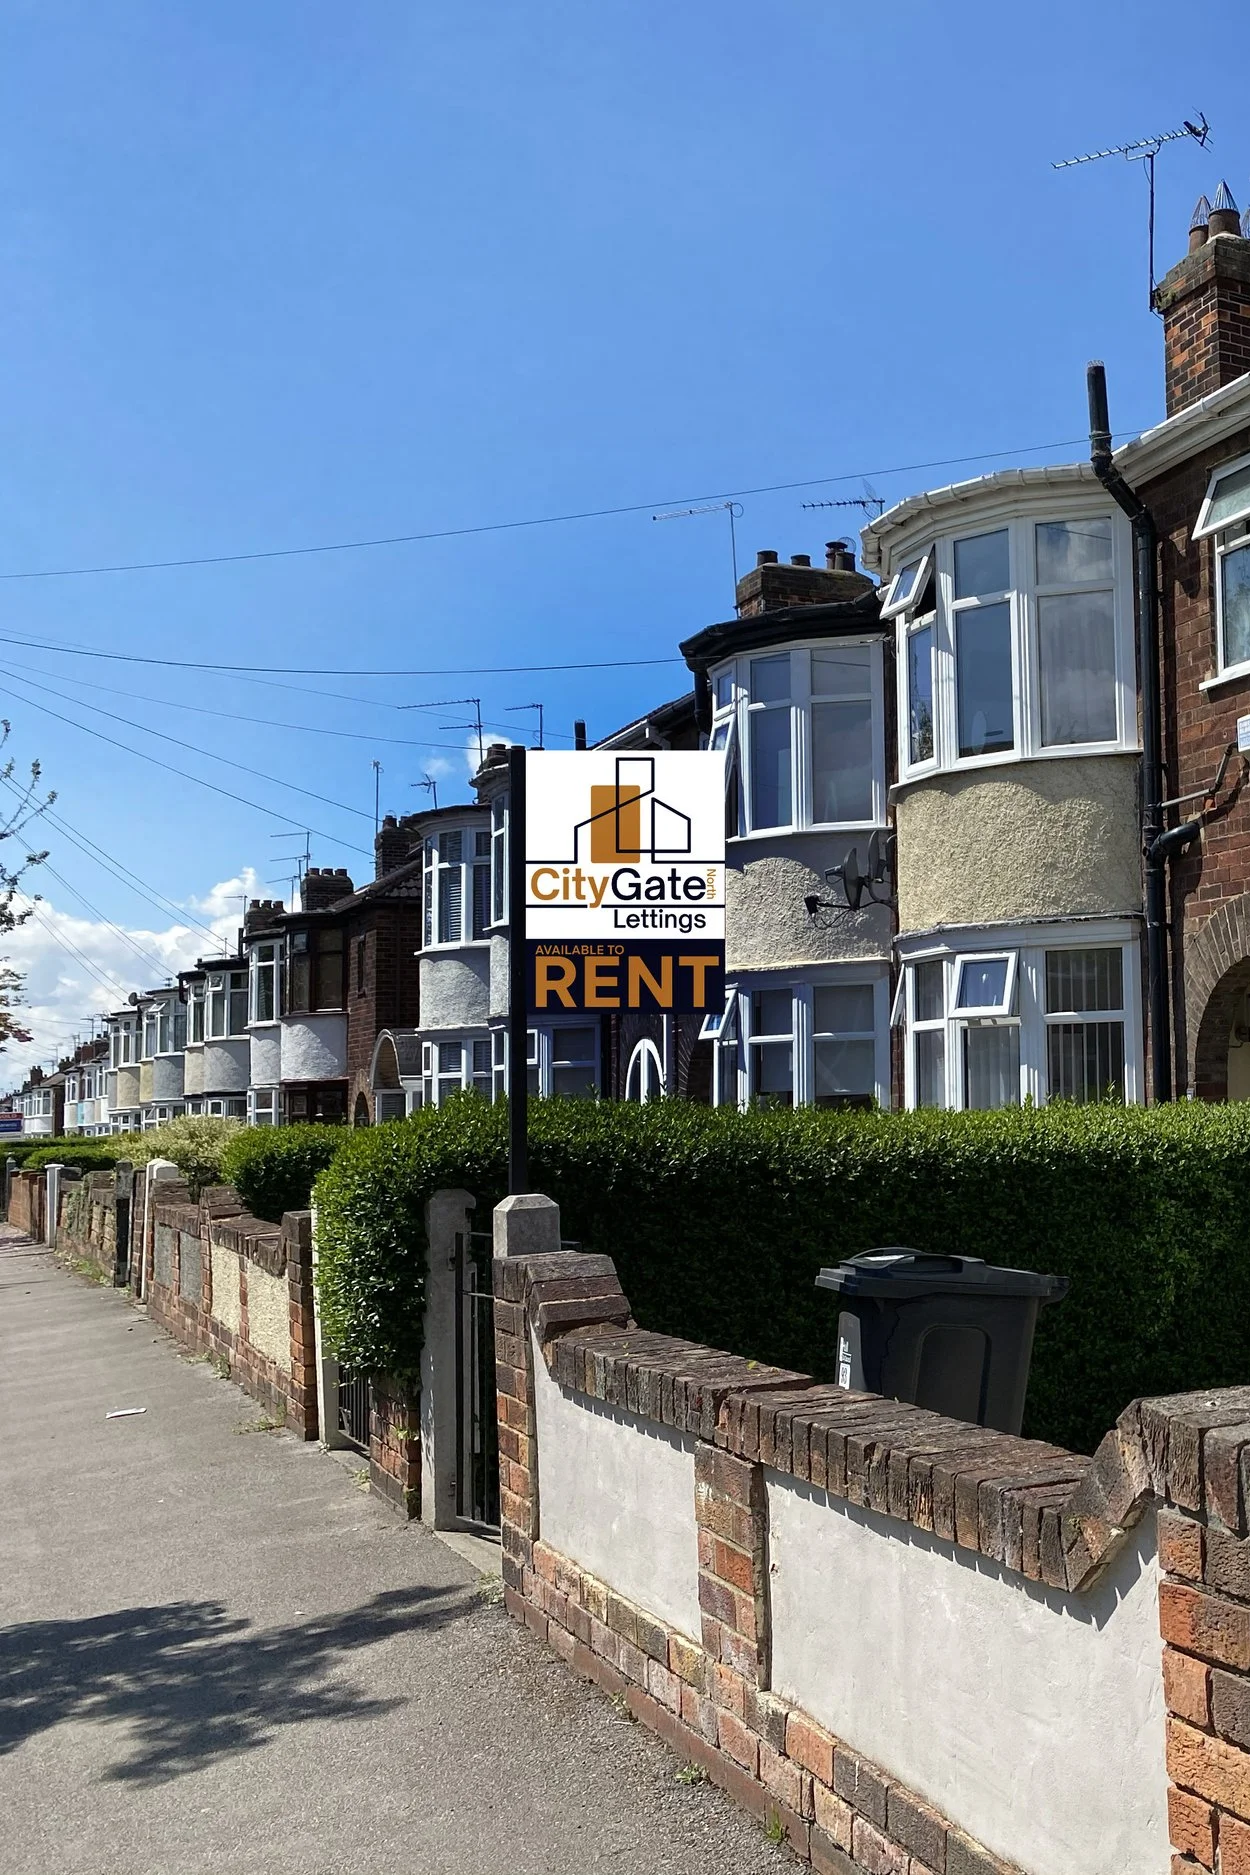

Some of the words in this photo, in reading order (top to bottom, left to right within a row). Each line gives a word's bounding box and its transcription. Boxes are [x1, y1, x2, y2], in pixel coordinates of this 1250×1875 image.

[531, 868, 706, 908] CityGate
[707, 868, 716, 900] North
[614, 909, 706, 933] Lettings
[535, 945, 604, 955] AVAILABLE
[607, 945, 625, 955] TO
[535, 956, 720, 1008] RENT
